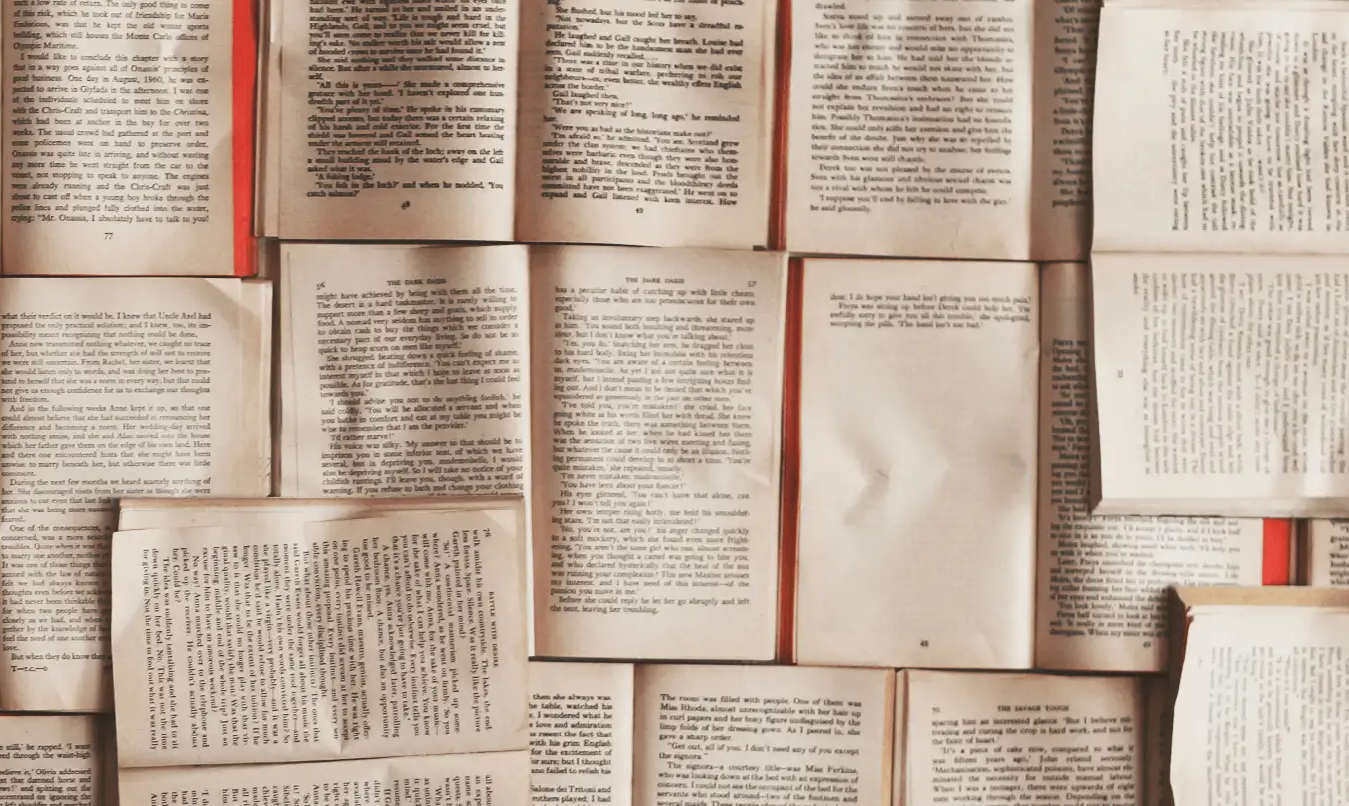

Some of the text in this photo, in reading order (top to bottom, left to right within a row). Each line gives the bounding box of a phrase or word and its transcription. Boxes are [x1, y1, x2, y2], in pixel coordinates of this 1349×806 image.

[63, 182, 91, 192] running
[96, 181, 110, 190] and
[113, 181, 126, 190] the
[130, 181, 171, 190] Chris-Craft
[195, 182, 209, 192] just
[402, 180, 485, 190] and when he nodded,
[400, 200, 411, 209] 48
[103, 232, 114, 240] 77
[316, 281, 326, 290] 56
[315, 291, 337, 302] might
[340, 290, 358, 299] have
[361, 289, 393, 298] achieved
[395, 288, 405, 299] by
[407, 288, 428, 299] being
[430, 287, 448, 296] with
[449, 286, 469, 295] them
[471, 286, 481, 294] all
[484, 285, 496, 294] the
[173, 548, 183, 604] her. Could he?
[453, 530, 467, 640] Gareth painted in her mind?
[660, 692, 676, 701] The
[720, 694, 740, 703] filled
[743, 695, 760, 703] with
[792, 696, 809, 705] One
[812, 697, 821, 705] of
[823, 697, 843, 706] them
[535, 720, 612, 728] love and admiration
[686, 732, 708, 742] sharp
